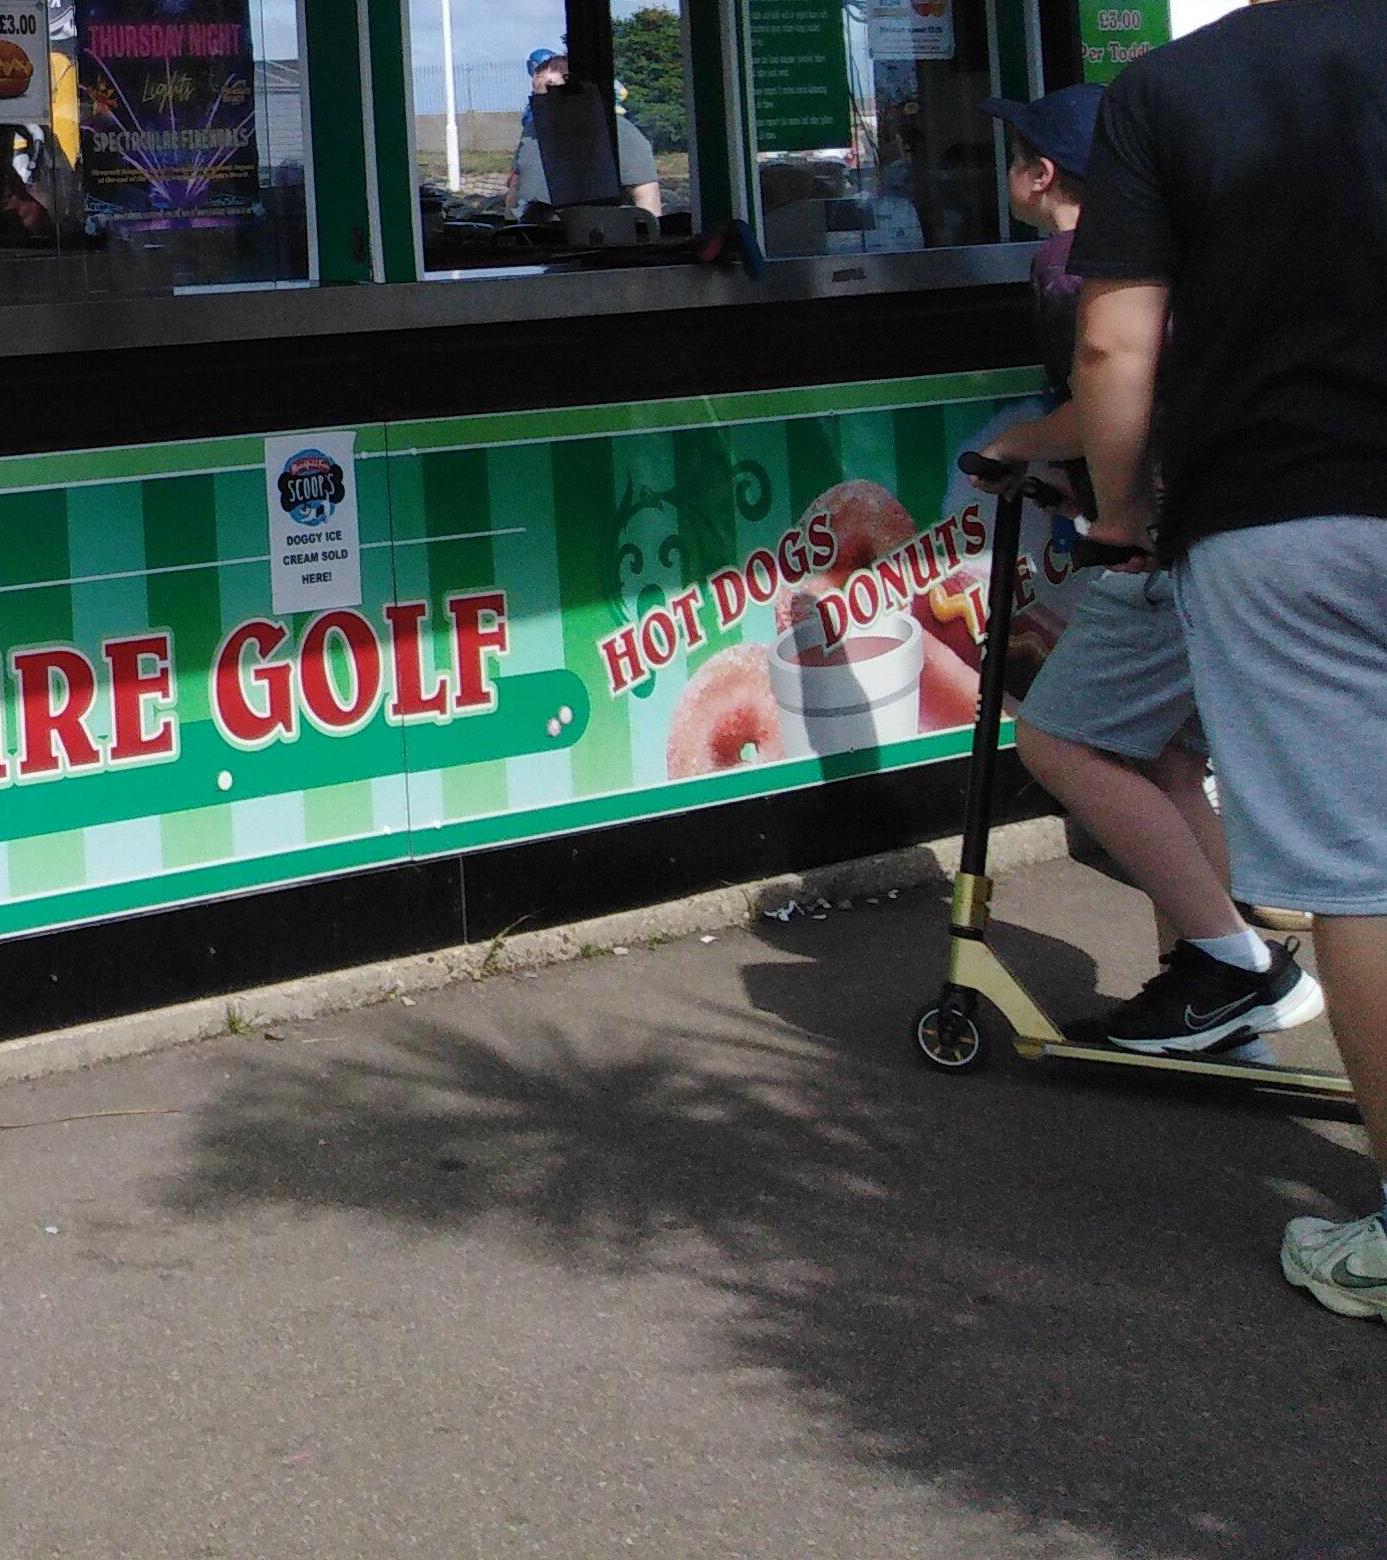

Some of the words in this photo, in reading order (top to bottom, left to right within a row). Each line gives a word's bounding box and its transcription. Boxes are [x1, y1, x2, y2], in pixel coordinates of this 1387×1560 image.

[0, 14, 37, 35] £3.00
[1098, 10, 1141, 30] £3.00
[89, 24, 185, 57] THURSDAY
[188, 23, 241, 56] NIGHT
[93, 130, 178, 153] SPECTACULAR
[288, 472, 335, 503] SCOOP'S
[286, 533, 322, 546] DOGGY
[325, 530, 342, 541] ICE
[283, 551, 319, 566] CREAM
[321, 548, 348, 561] SOLD
[301, 571, 332, 585] HERE!
[816, 504, 986, 648] DONUTS
[601, 590, 704, 694] HOT
[712, 514, 836, 627] DOGS
[216, 593, 508, 746] GOLF
